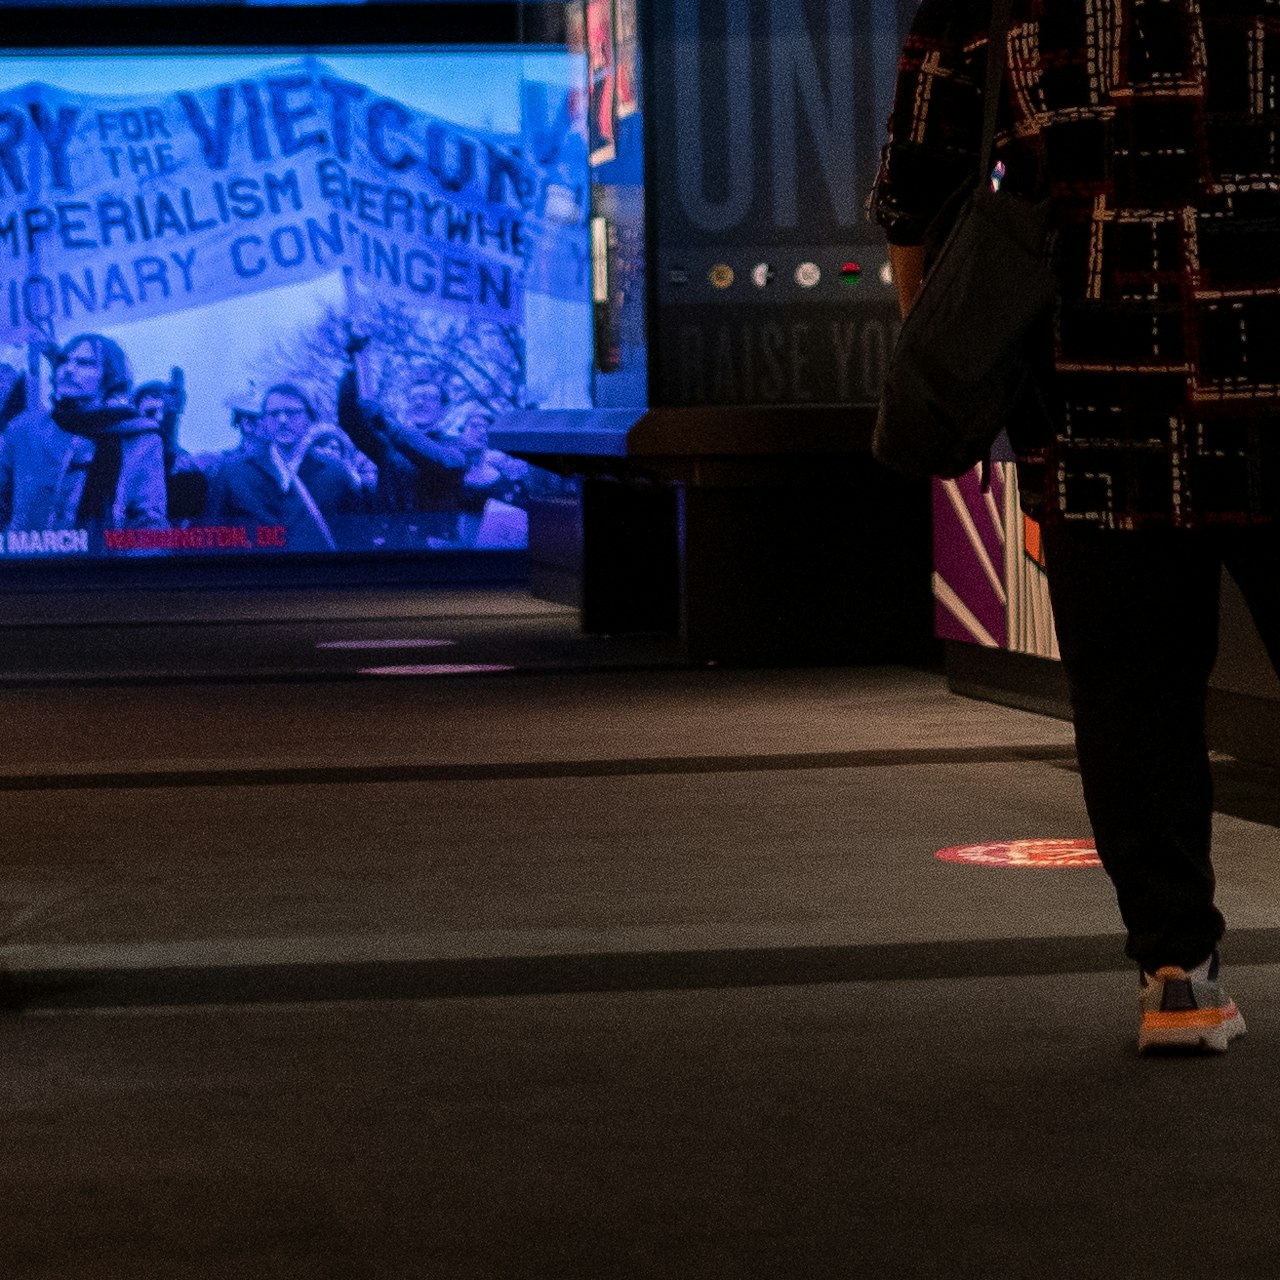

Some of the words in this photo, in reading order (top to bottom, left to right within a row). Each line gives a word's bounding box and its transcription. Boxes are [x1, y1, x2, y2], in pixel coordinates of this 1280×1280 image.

[97, 106, 166, 143] FOR
[101, 142, 177, 180] THE
[8, 529, 89, 553] MARCH
